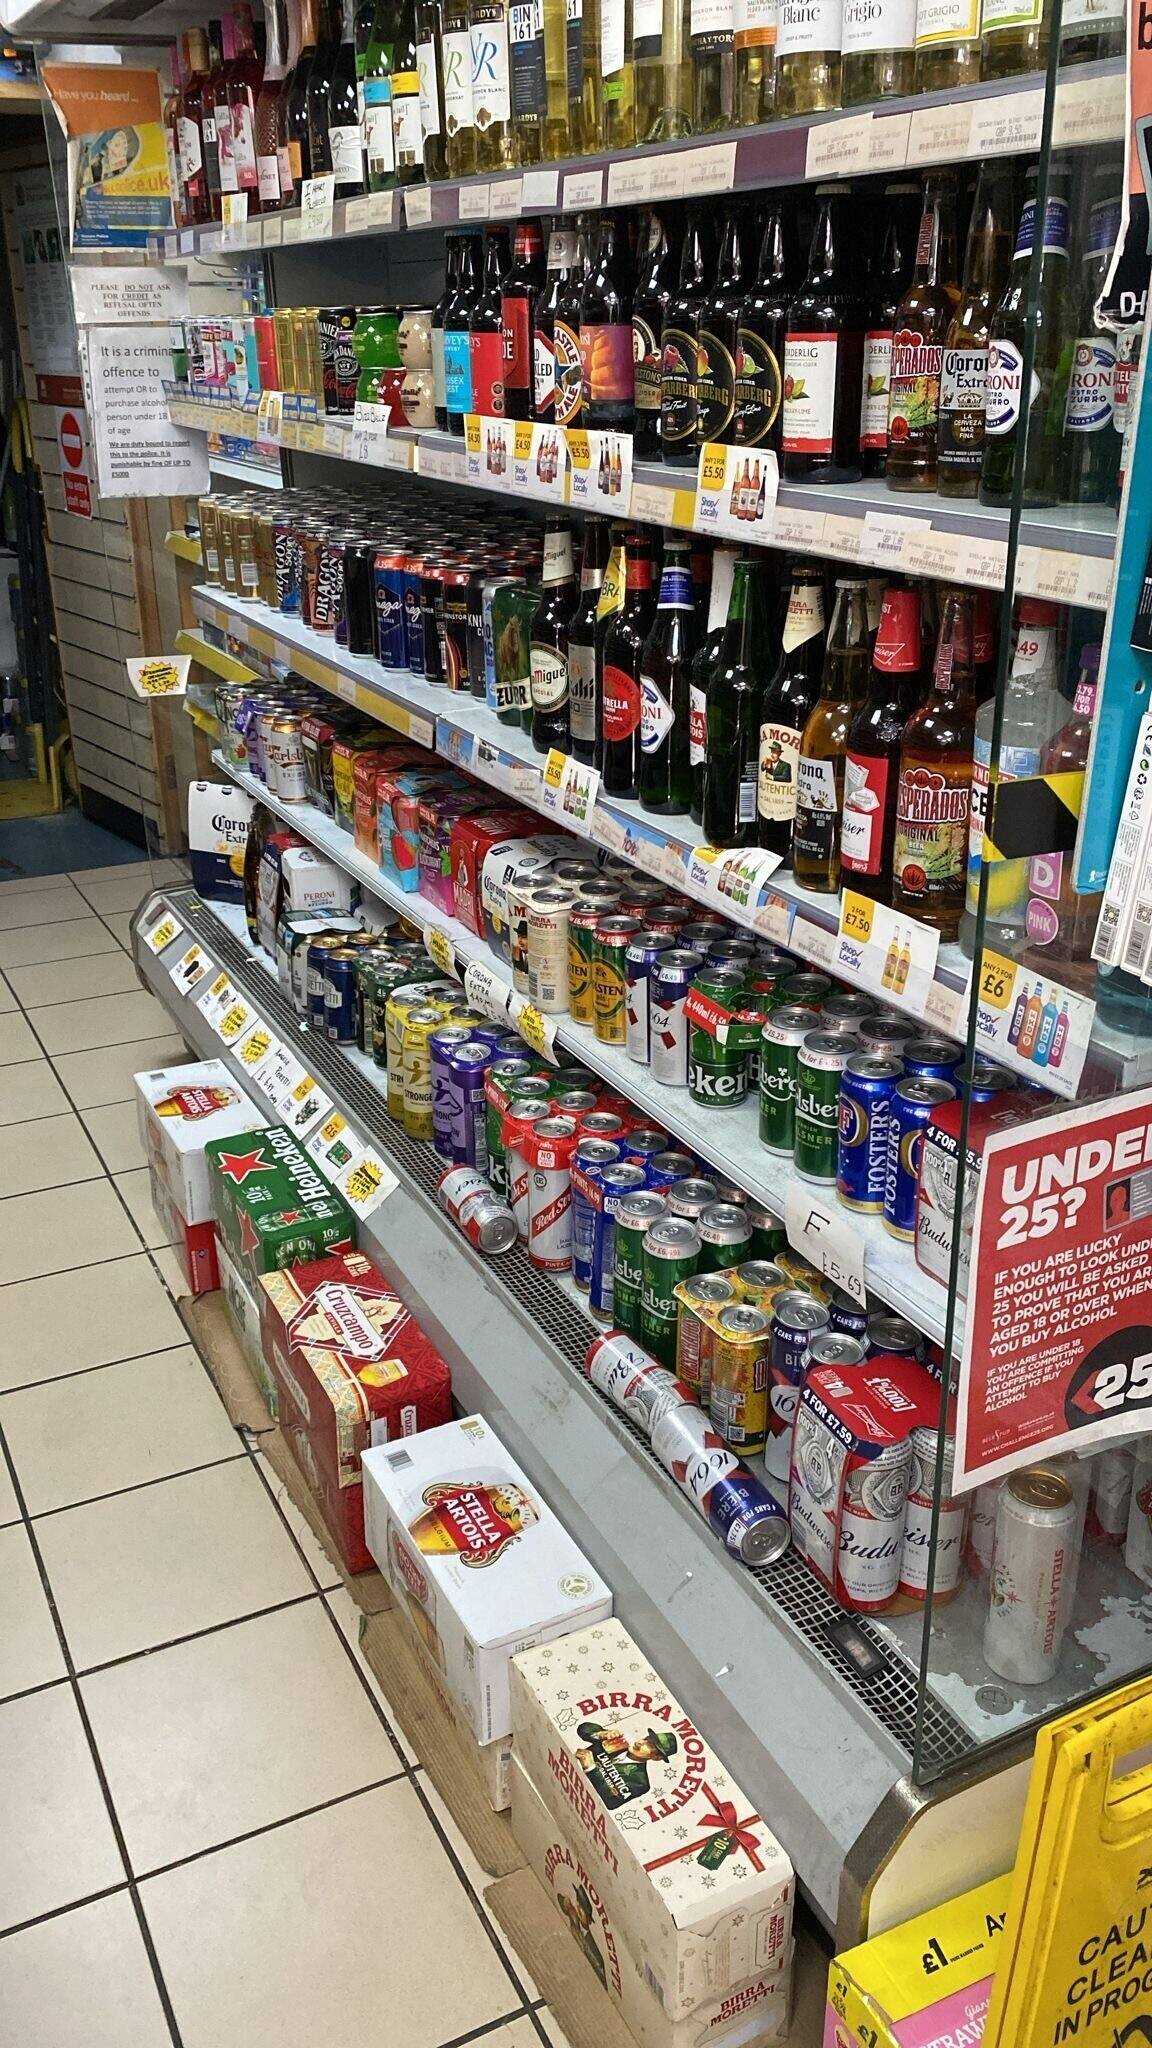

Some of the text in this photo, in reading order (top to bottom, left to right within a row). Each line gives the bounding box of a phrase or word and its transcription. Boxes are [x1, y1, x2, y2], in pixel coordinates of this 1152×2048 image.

[513, 7, 531, 23] BIN
[783, 5, 820, 25] Blanc
[928, 5, 960, 18] GRIGIO
[513, 22, 532, 40] 161
[101, 346, 173, 356] It is a crimina
[103, 366, 160, 377] offence to
[104, 386, 134, 395] attempt
[136, 385, 147, 393] OR
[105, 400, 139, 408] purchase
[106, 414, 132, 422] person
[466, 432, 481, 444] £4.50
[515, 438, 531, 451] £4.50
[572, 447, 591, 459] £5.50
[703, 465, 724, 480] £5.50
[573, 483, 589, 496] Locally
[700, 507, 718, 519] Locally
[701, 496, 715, 509] Shop
[304, 890, 336, 901] PERONI
[845, 913, 870, 933] £7.50
[856, 908, 866, 917] FOR
[1028, 909, 1052, 933] PINK
[839, 951, 862, 970] Locally
[842, 941, 857, 956] Shop
[468, 965, 493, 987] CORONA
[983, 960, 995, 972] ANY
[1000, 968, 1013, 981] FOR
[982, 974, 1004, 998] £6
[181, 1093, 201, 1115] ARTOIS
[192, 1089, 215, 1112] STELLA
[867, 1100, 890, 1194] FOSTER'S
[926, 1126, 957, 1151] 4 FOR
[264, 1127, 332, 1203] Heineken
[540, 1151, 552, 1160] NO
[1002, 1124, 1152, 1204] UNDE
[607, 1197, 619, 1207] NO
[803, 1211, 830, 1236] F
[996, 1187, 1087, 1250] 25?
[994, 1233, 1122, 1285] IF YOU ARE LUCKY
[994, 1238, 1152, 1300] ENOUGH TO LOOK UND
[822, 1252, 862, 1297] £5.69
[992, 1254, 1149, 1315] 25 YOU WILL BE ASKED
[990, 1279, 1152, 1345] AGED 18 OR OVER WHEN
[991, 1314, 1011, 1329] TO
[1015, 1297, 1061, 1322] PROVE
[1064, 1283, 1099, 1304] THAT
[1102, 1273, 1130, 1291] YOU
[325, 1289, 374, 1349] Cruzcampo
[989, 1305, 1117, 1358] YOU BUY ALCOHOL
[778, 1329, 793, 1341] CANS
[793, 1333, 807, 1344] FOR
[986, 1345, 1085, 1387] YOU ARE COMMITTING
[987, 1339, 1081, 1378] IF YOU ARE UNDER 18
[985, 1358, 1073, 1396] AN OFFENCE IF YOU
[985, 1370, 1061, 1404] ATTEMPT TO BUY
[984, 1393, 1028, 1414] ALCOHOL
[803, 1389, 852, 1445] 4 FOR £7.59
[982, 1424, 1055, 1457] WWW.CHALLENGE25.ORG
[443, 1498, 487, 1550] ARTOIS
[460, 1492, 502, 1544] STELLA
[791, 1489, 835, 1553] Budweiser
[1043, 1546, 1064, 1655] STELLA ARTOIS
[576, 1691, 705, 1823] BIRRA MORETTI
[596, 1752, 632, 1800] L'AUTENTICA
[558, 1746, 608, 1832] BIRRA
[547, 1755, 620, 1877] MORETTI
[922, 1937, 949, 1975] £1
[710, 1983, 776, 2027] MORETTI
[720, 1979, 766, 2012] BIRRA
[1053, 2013, 1081, 2046] IN
